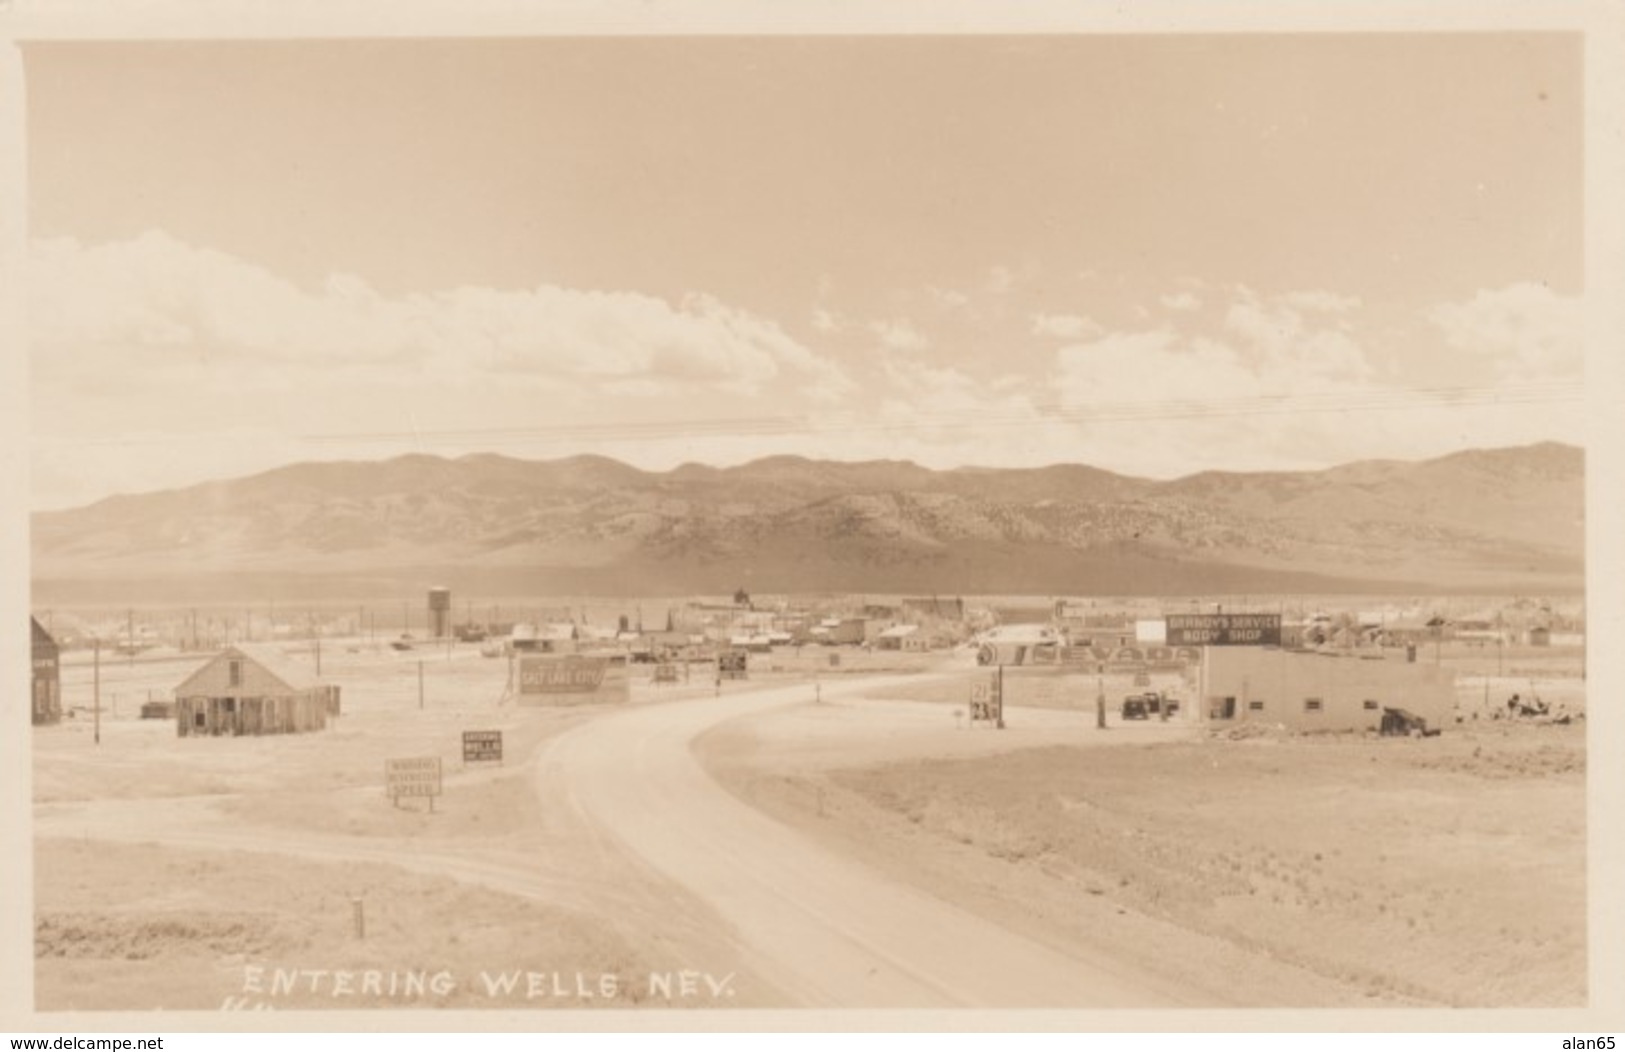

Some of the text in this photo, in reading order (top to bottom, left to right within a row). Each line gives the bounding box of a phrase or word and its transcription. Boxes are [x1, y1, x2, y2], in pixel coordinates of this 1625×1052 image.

[1183, 629, 1262, 641] BODY SHOP
[1033, 646, 1200, 661] NEVADA
